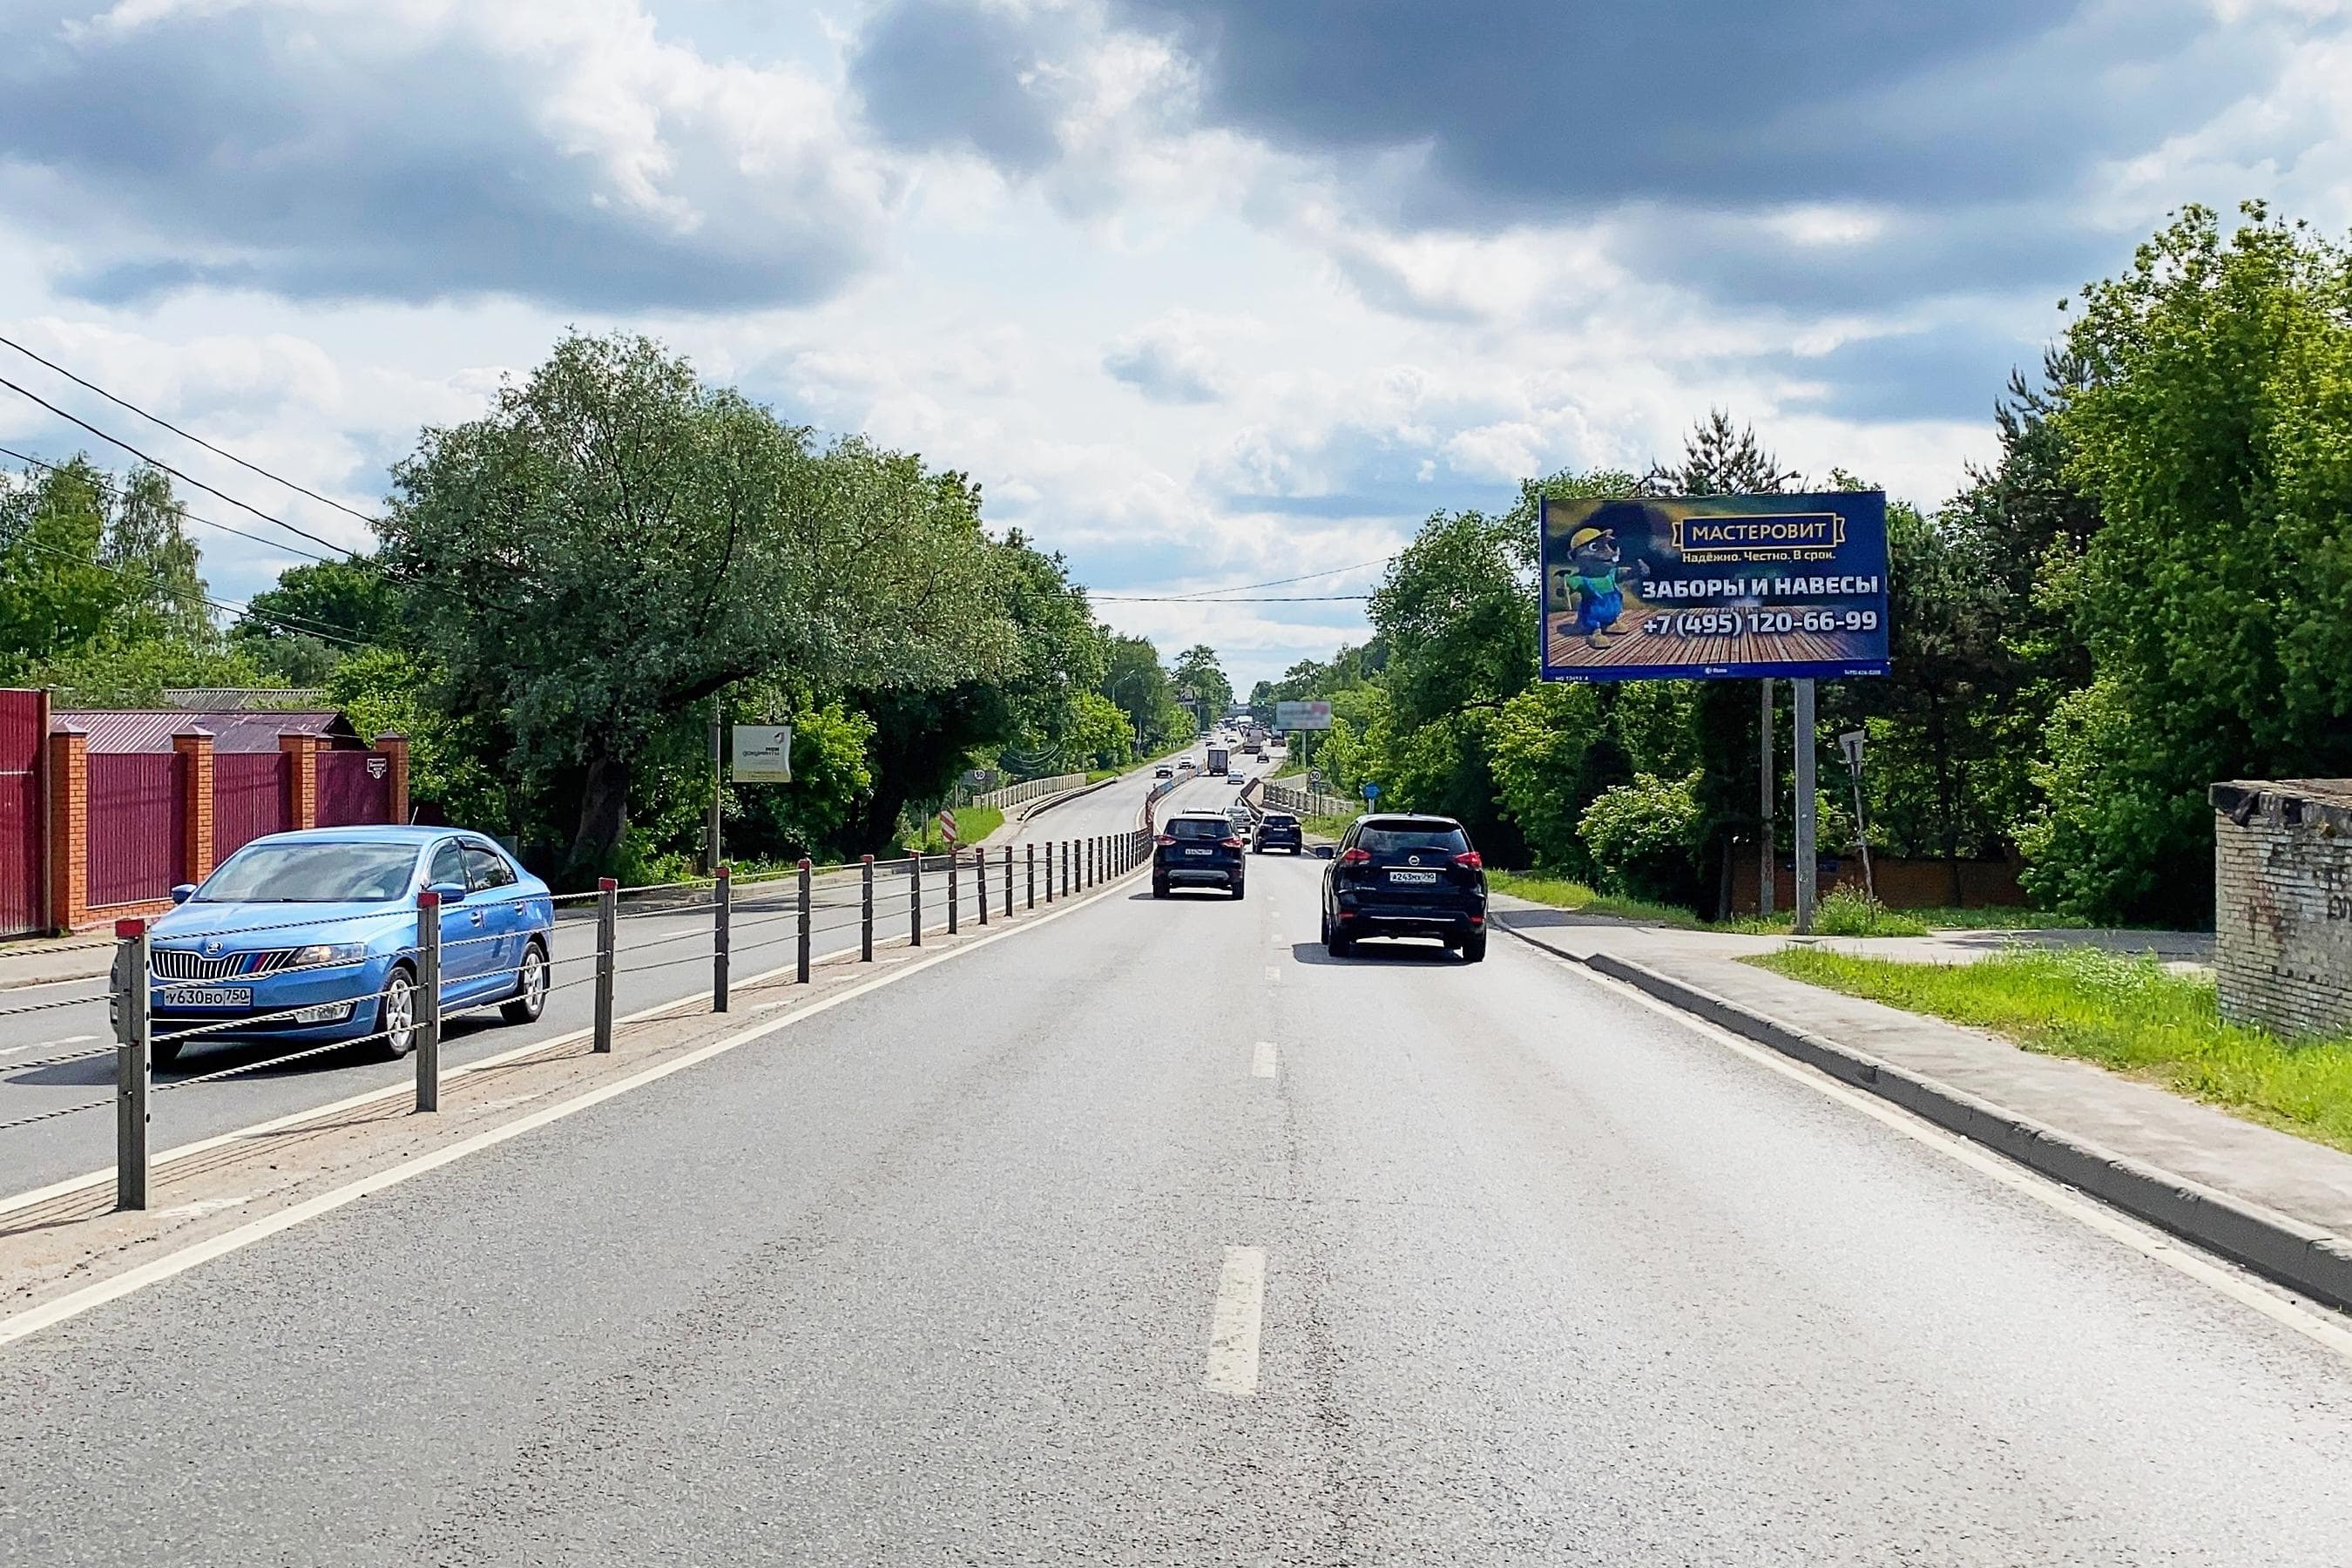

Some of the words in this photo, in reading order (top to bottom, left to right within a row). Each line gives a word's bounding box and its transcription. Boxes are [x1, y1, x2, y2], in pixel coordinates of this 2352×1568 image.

[1693, 523, 1827, 542] МАСТЕРОВИТ
[1682, 551, 1741, 564] Надёжно.
[1744, 551, 1791, 561] Честно.
[1793, 550, 1801, 560] В
[1804, 551, 1835, 562] срок.
[1641, 578, 1746, 598] ЗАБОРЫ
[1751, 578, 1768, 596] И
[1774, 576, 1878, 596] НАВЕСЫ
[1643, 615, 1671, 635] +7
[1676, 612, 1742, 638] (495)
[1747, 611, 1877, 633] 120-66-99
[225, 989, 247, 1001] 750
